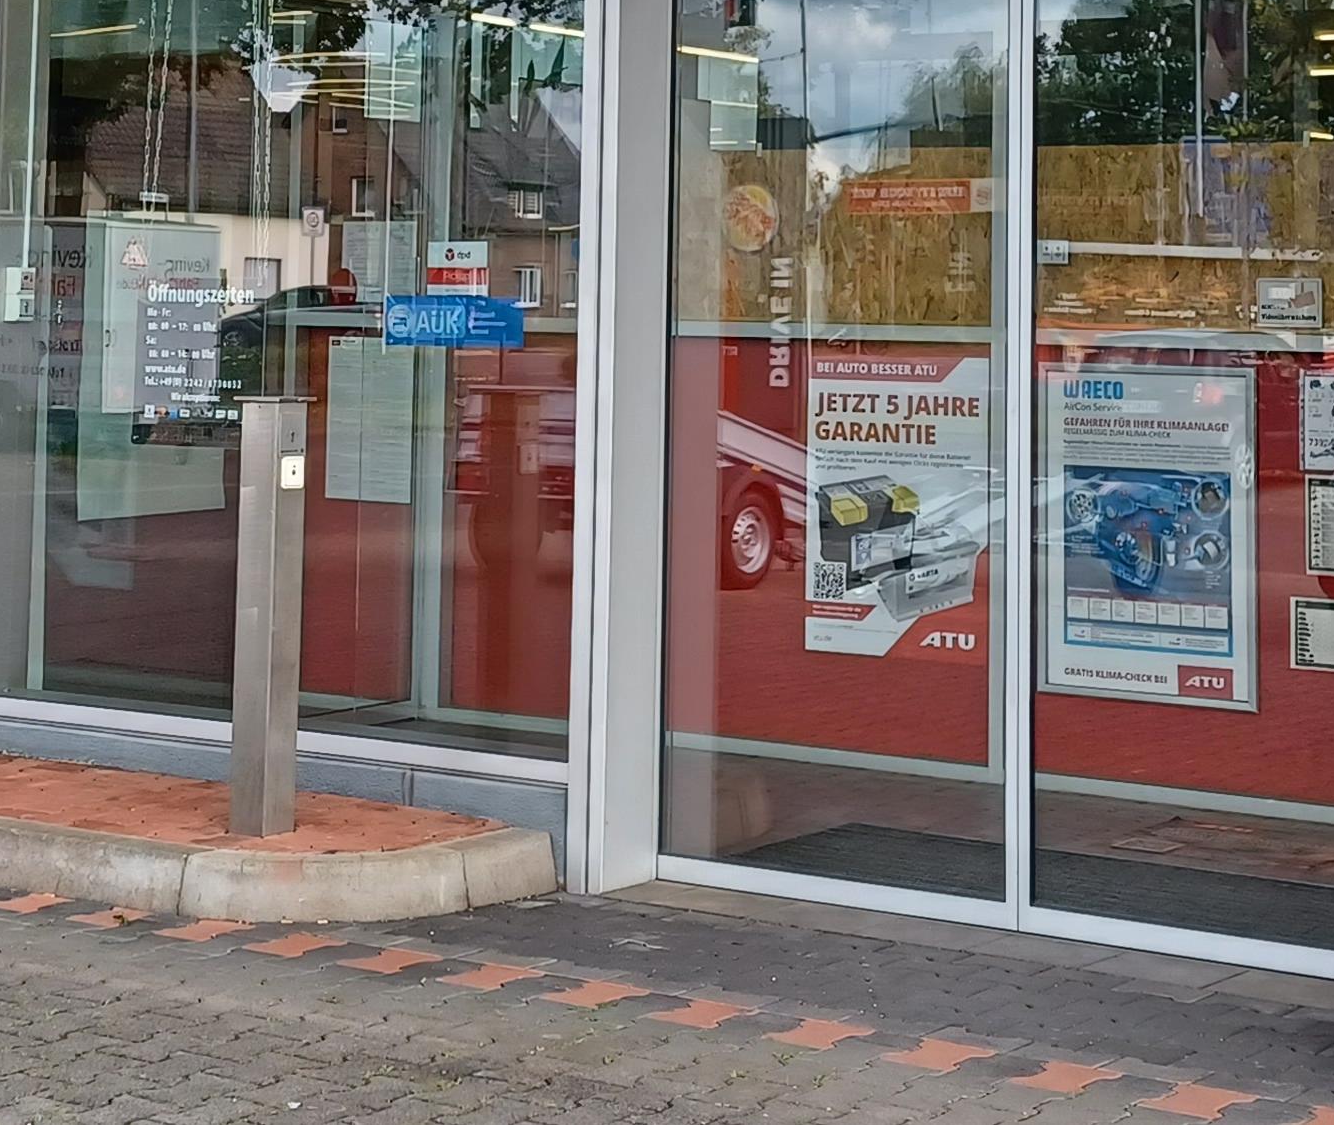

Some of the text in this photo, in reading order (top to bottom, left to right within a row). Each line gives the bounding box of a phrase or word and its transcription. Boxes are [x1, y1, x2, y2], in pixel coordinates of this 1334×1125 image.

[147, 281, 255, 307] Öffnungszeiten
[817, 362, 937, 376] BEI AUTO BESSER ATU
[814, 392, 980, 420] JETZT 5 JAHRE
[814, 421, 936, 445] GARANTIE
[1063, 417, 1111, 427] GEFAHREN
[1113, 417, 1131, 428] FÜR
[1133, 419, 1155, 429] IHRE
[919, 631, 976, 651] ATU
[1154, 675, 1167, 684] BEI
[1185, 675, 1225, 689] ATU
